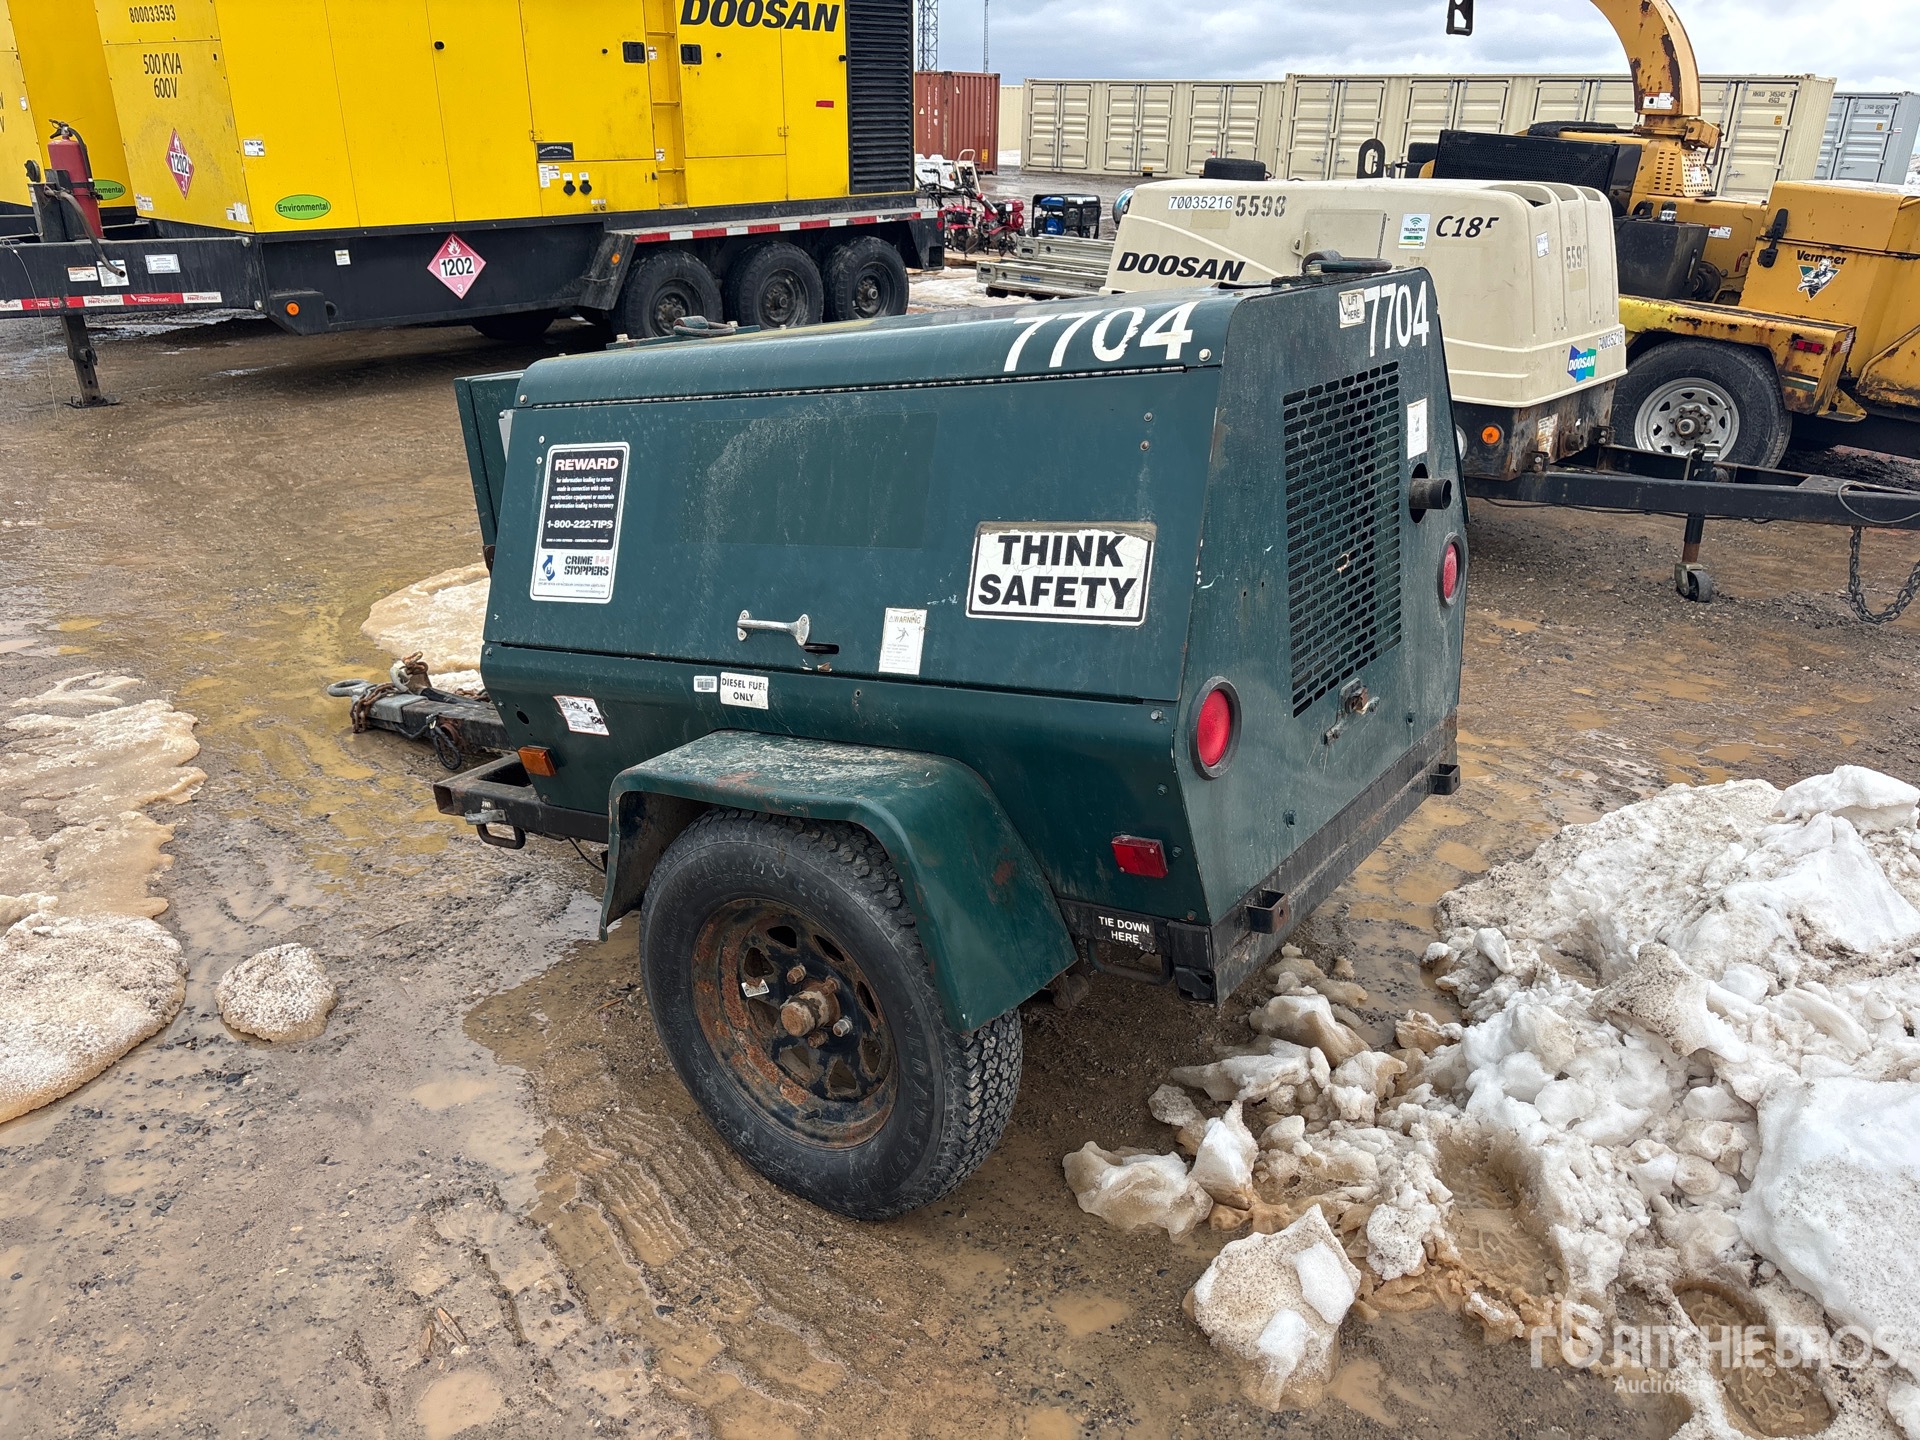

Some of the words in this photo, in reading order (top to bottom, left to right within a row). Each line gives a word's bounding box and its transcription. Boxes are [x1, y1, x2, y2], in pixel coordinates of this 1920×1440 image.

[129, 4, 176, 23] 800033593
[680, 0, 840, 32] DOOSAN
[143, 53, 161, 74] 500
[161, 53, 183, 74] KVA
[154, 77, 177, 98] 600V
[171, 153, 189, 174] 1202
[278, 202, 329, 213] Environmental
[1170, 196, 1233, 209] 70035216
[1235, 195, 1287, 217] 5598
[441, 257, 474, 276] 1202
[1117, 252, 1246, 282] DOOSAN
[457, 283, 464, 293] 3
[1347, 295, 1358, 306] LIFT
[1347, 309, 1361, 321] HERE
[1364, 280, 1430, 358] 7704
[1003, 300, 1201, 372] 7704
[1568, 356, 1596, 371] DOOSAN
[554, 457, 619, 471] REWARD
[546, 520, 613, 529] 1-800-222-TIPS
[997, 535, 1127, 567] THINK
[565, 555, 594, 565] CRIME
[564, 565, 609, 576] STOPPERS
[978, 574, 1138, 610] SAFETY
[893, 615, 922, 625] WARNING
[722, 677, 746, 689] DIESEL
[748, 681, 767, 691] FUEL
[732, 691, 754, 701] ONLY
[1098, 915, 1115, 927] TIE
[1117, 919, 1150, 934] DOWN
[1110, 930, 1140, 944] HERE
